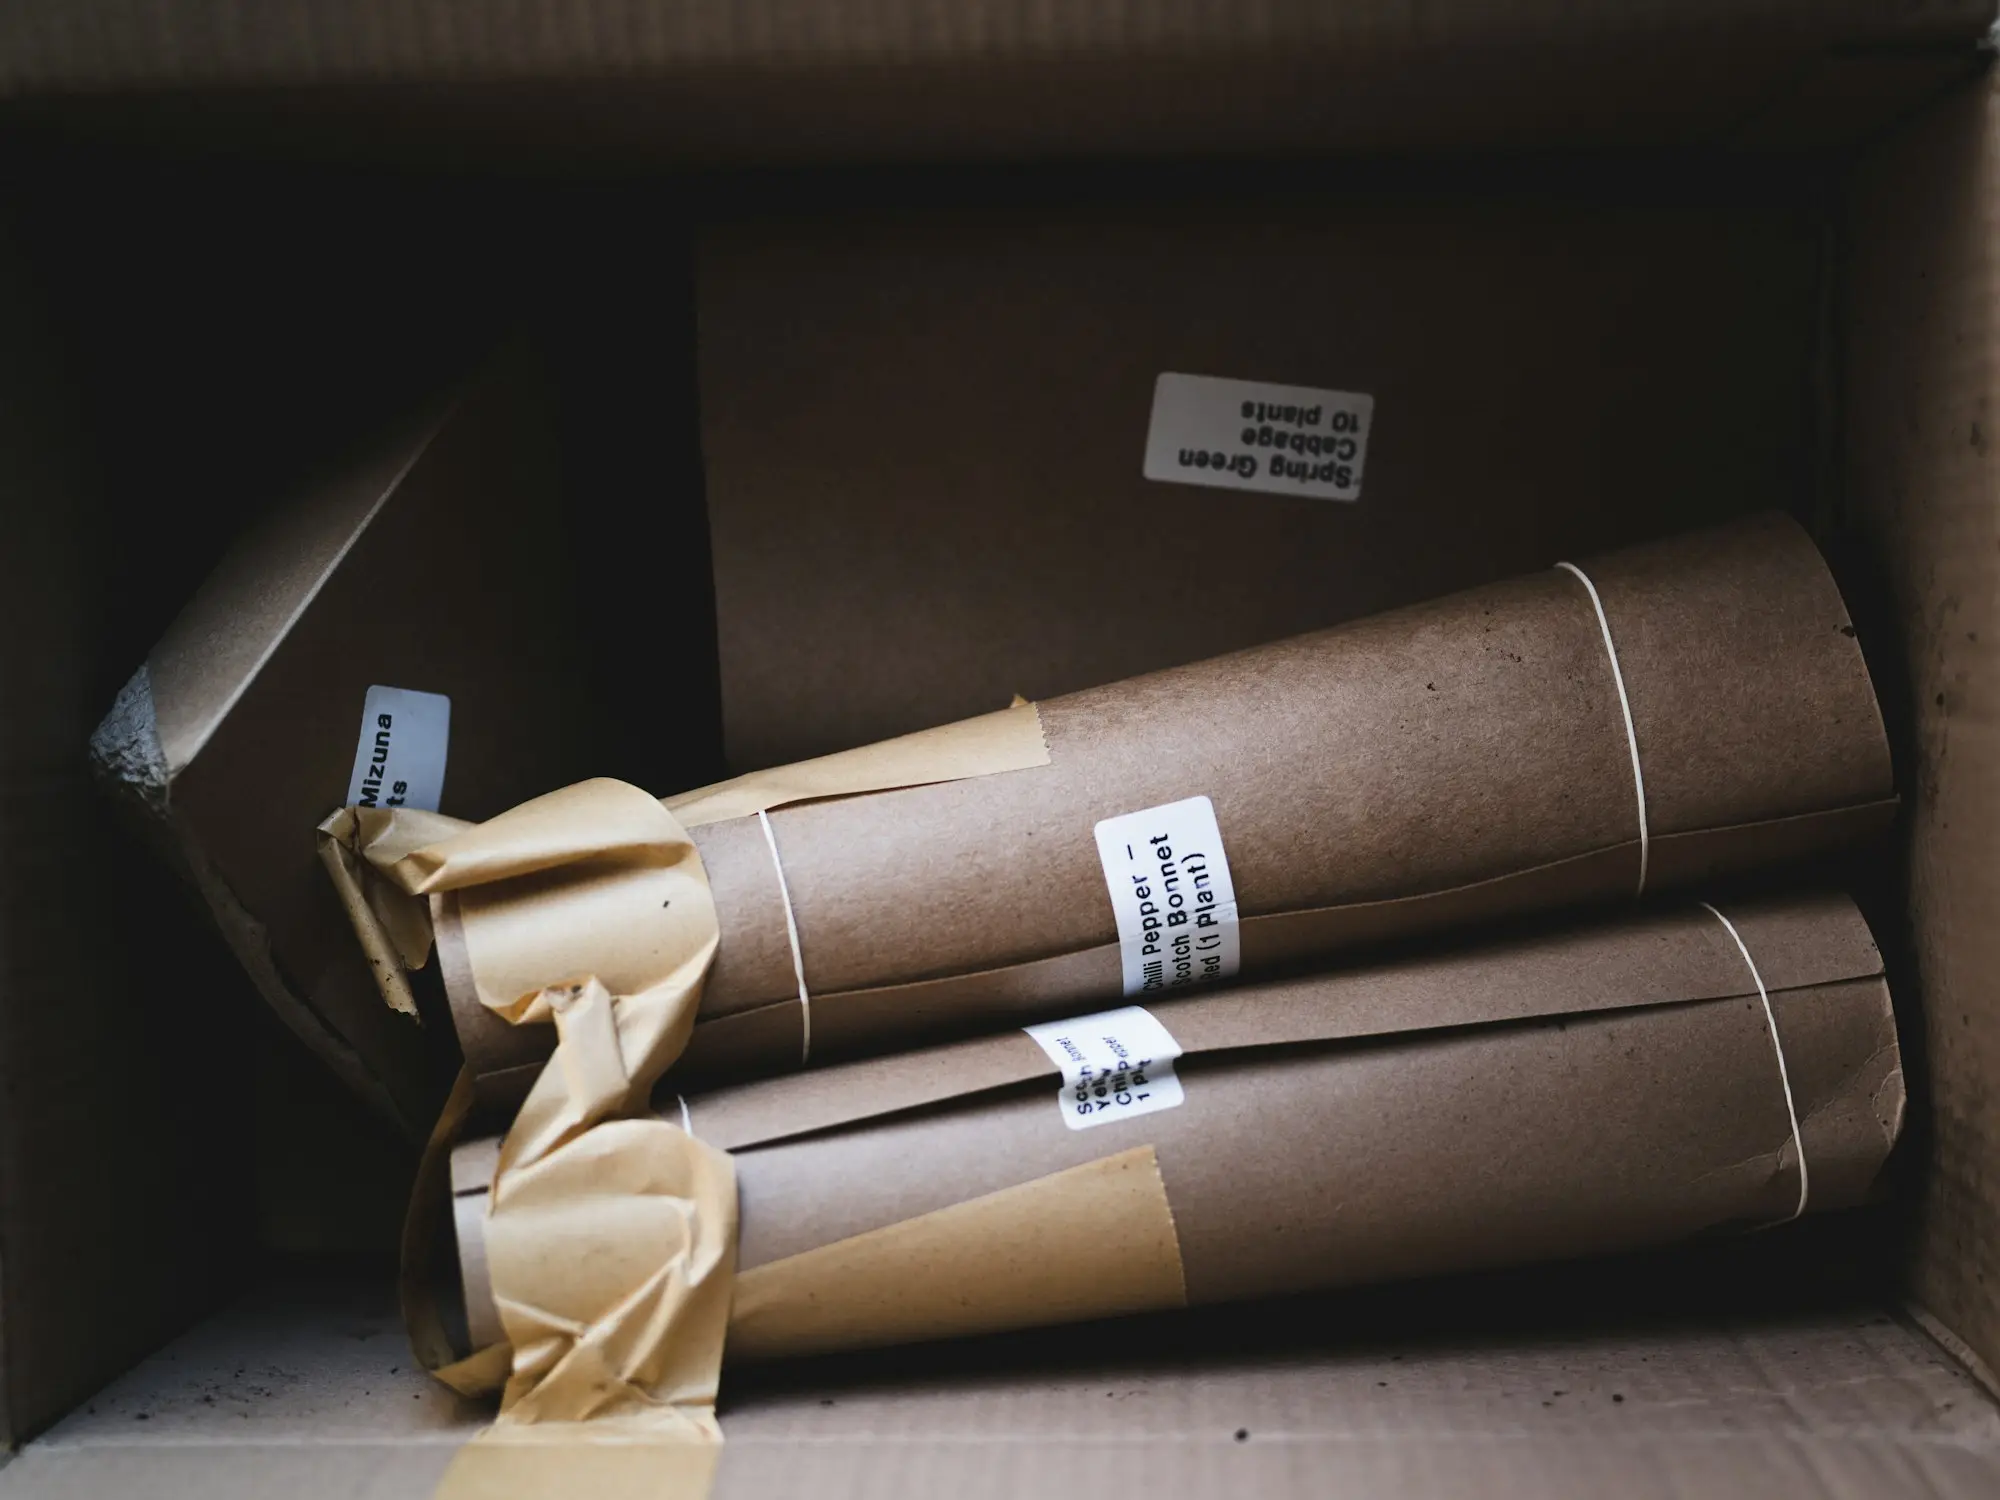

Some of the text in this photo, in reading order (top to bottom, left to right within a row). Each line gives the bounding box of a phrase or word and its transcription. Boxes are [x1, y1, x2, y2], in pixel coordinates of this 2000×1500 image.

[1240, 401, 1360, 433] 10 plants
[1240, 426, 1357, 461] Cabbage
[1178, 448, 1353, 490] Spring Green
[358, 713, 392, 808] Mizuna
[1132, 874, 1163, 956] Pepper
[1149, 833, 1192, 984] Scotch Bonnet
[1181, 852, 1221, 979] Red (1 Plant)
[1143, 960, 1163, 991] Chilli
[1137, 1092, 1151, 1102] 1
